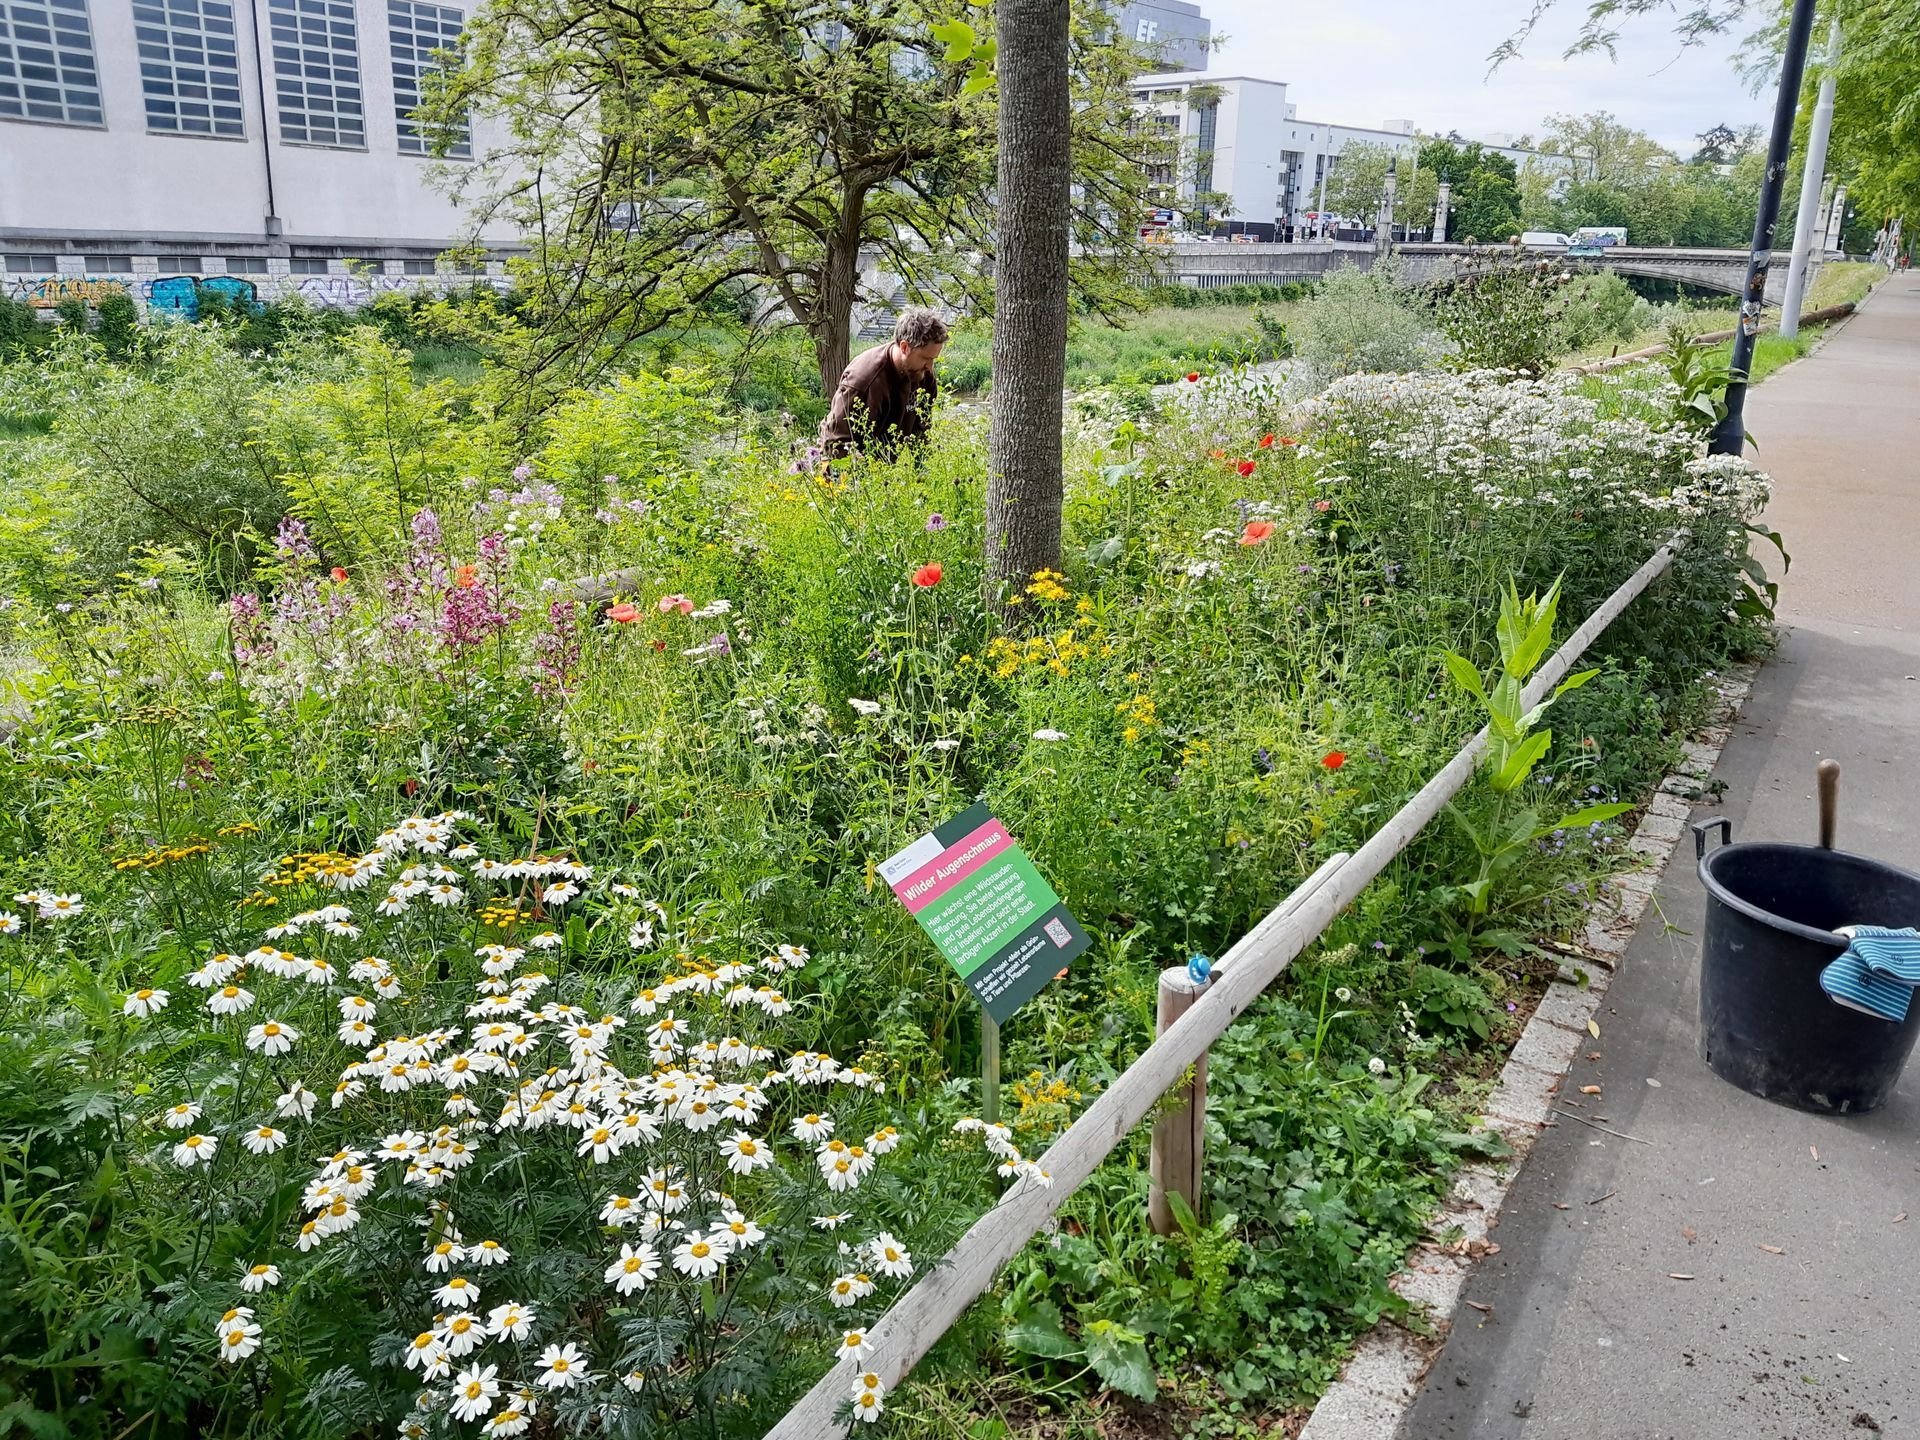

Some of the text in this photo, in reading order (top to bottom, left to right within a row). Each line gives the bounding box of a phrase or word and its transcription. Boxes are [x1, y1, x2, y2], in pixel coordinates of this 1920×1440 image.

[1136, 19, 1158, 43] EF
[904, 875, 936, 900] Wilder
[935, 831, 1001, 880] Augenschmaus
[926, 914, 941, 927] Hier
[940, 898, 964, 917] wächst
[962, 888, 977, 901] eine
[933, 871, 1019, 938] Pflanzung. Sie bietet Nahrung
[940, 880, 1027, 946] und gute Lebensbedingungen
[948, 893, 1026, 955] für Insekten und setzt einen
[955, 899, 1035, 966] farbigen Akzent in der Stadt.
